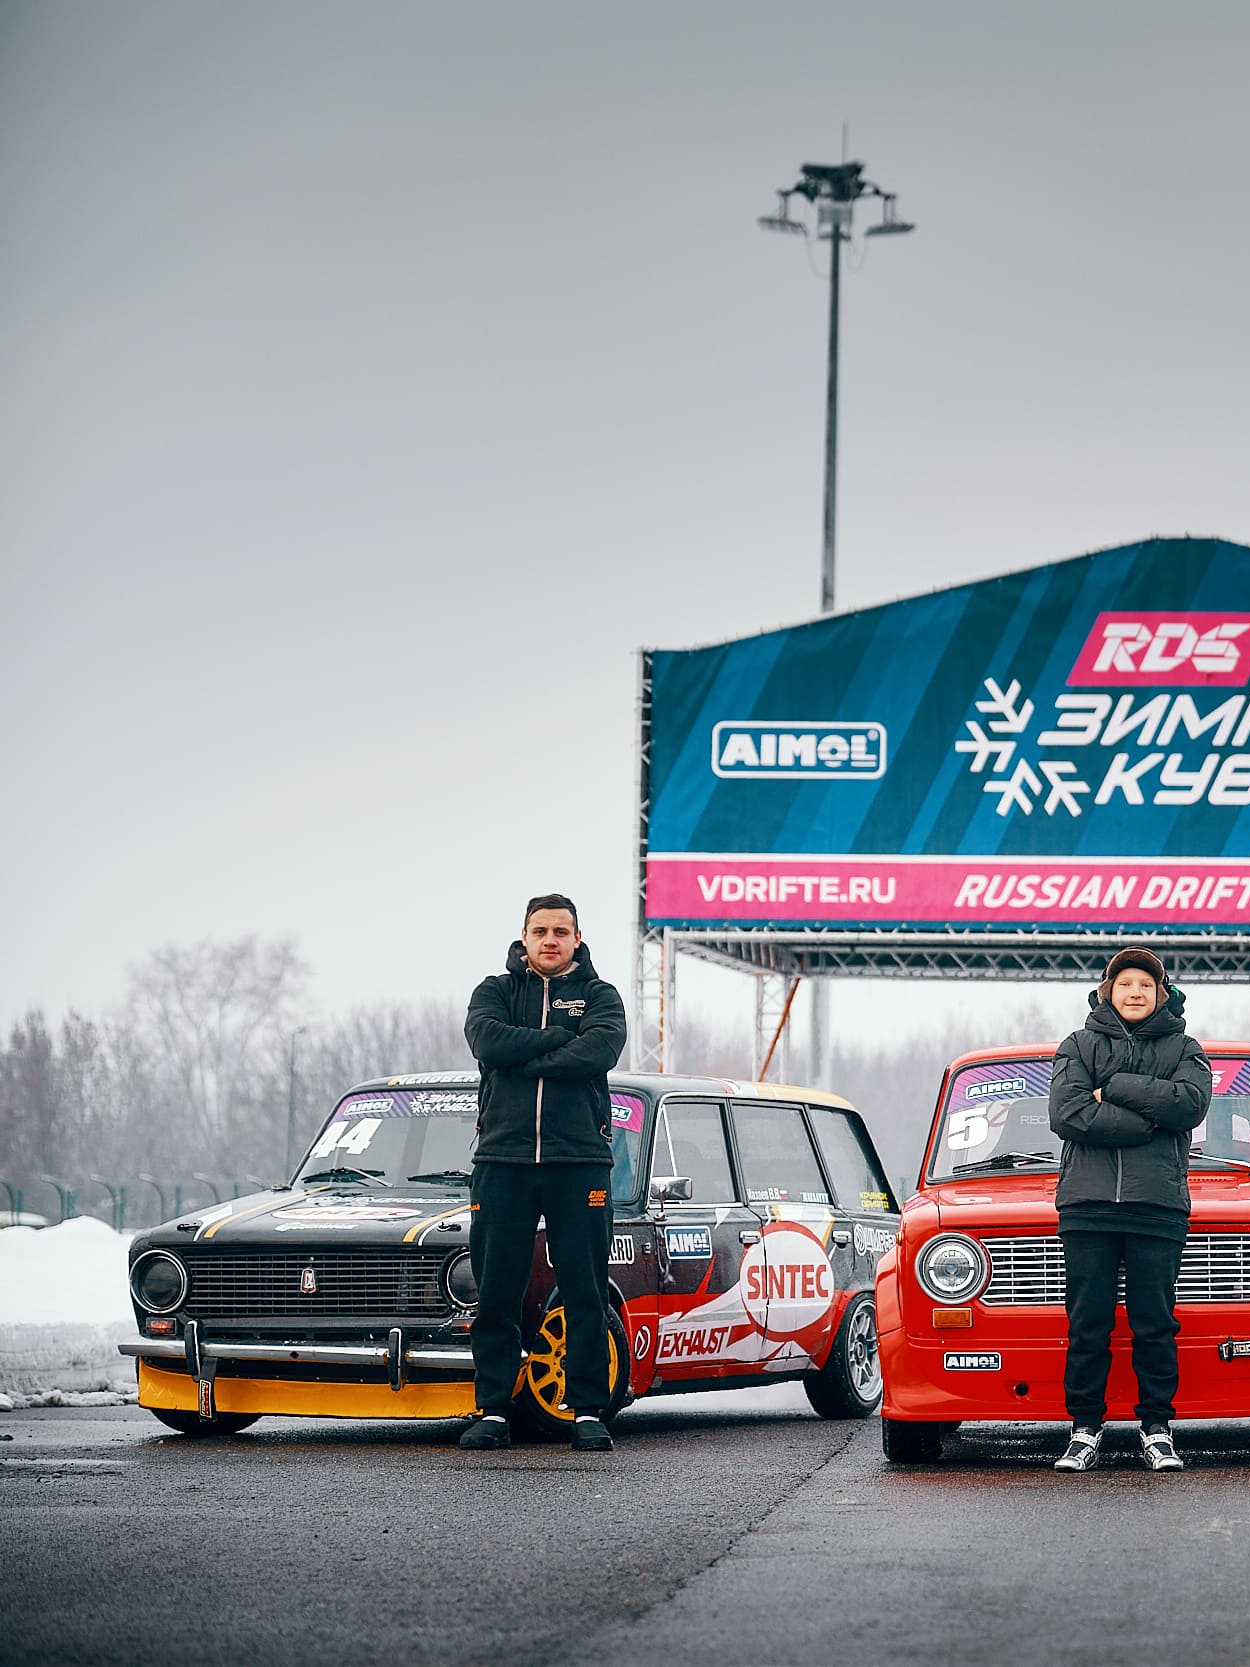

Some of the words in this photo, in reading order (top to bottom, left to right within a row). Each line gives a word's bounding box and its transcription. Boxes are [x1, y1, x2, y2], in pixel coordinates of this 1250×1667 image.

[1092, 623, 1250, 673] RDS
[720, 733, 877, 768] AIMOL
[697, 875, 896, 905] VDRIFTE.RU
[954, 875, 1136, 909] RUSSIAN
[968, 1080, 1022, 1097] AIMOL
[310, 1117, 384, 1158] 44
[947, 1106, 989, 1151] 5
[669, 1233, 710, 1252] AIMOL
[747, 1264, 829, 1300] SINTEC
[659, 1327, 728, 1358] EXHAUST
[946, 1355, 999, 1368] AIMOL
